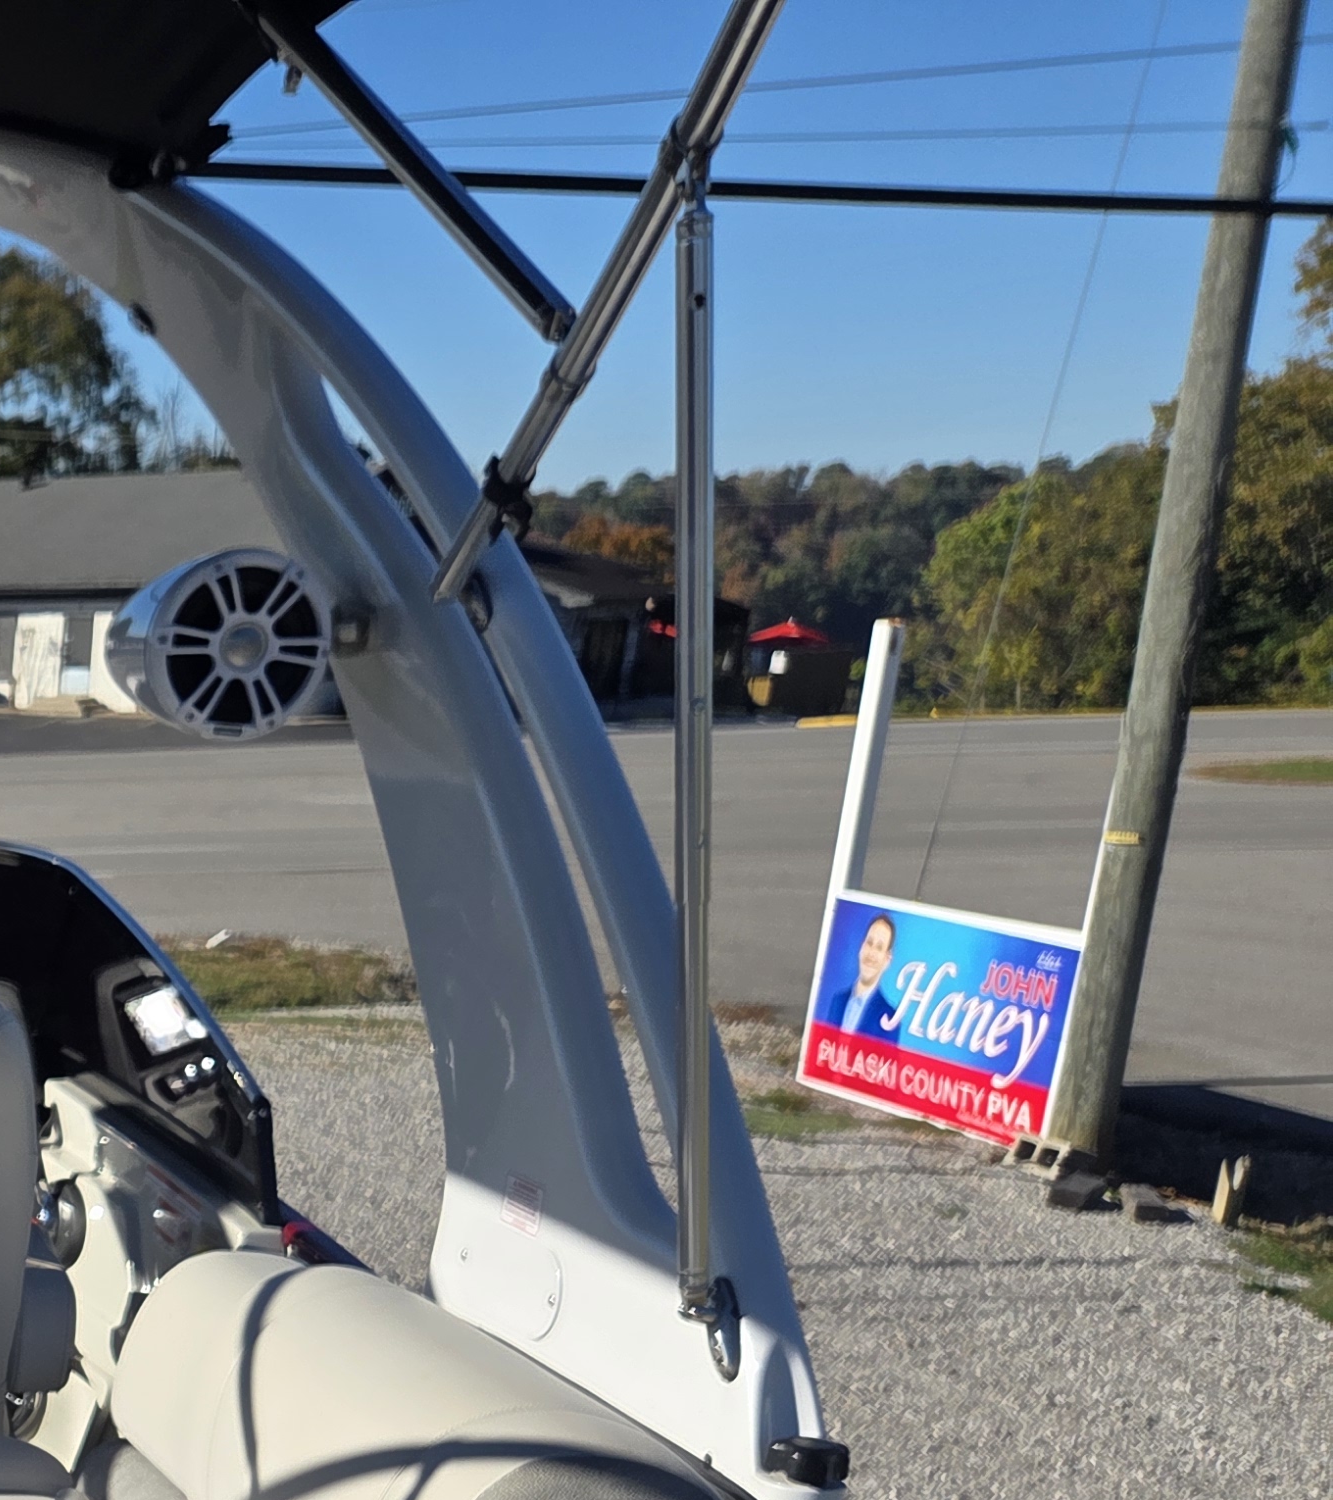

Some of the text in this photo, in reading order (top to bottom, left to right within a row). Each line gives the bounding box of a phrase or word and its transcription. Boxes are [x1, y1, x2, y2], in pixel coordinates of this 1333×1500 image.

[880, 962, 1049, 1088] Haney
[980, 958, 1059, 1012] JOHN
[815, 1037, 898, 1091] PULASKI
[899, 1063, 985, 1115] COUNTY
[986, 1089, 1032, 1133] PVA
